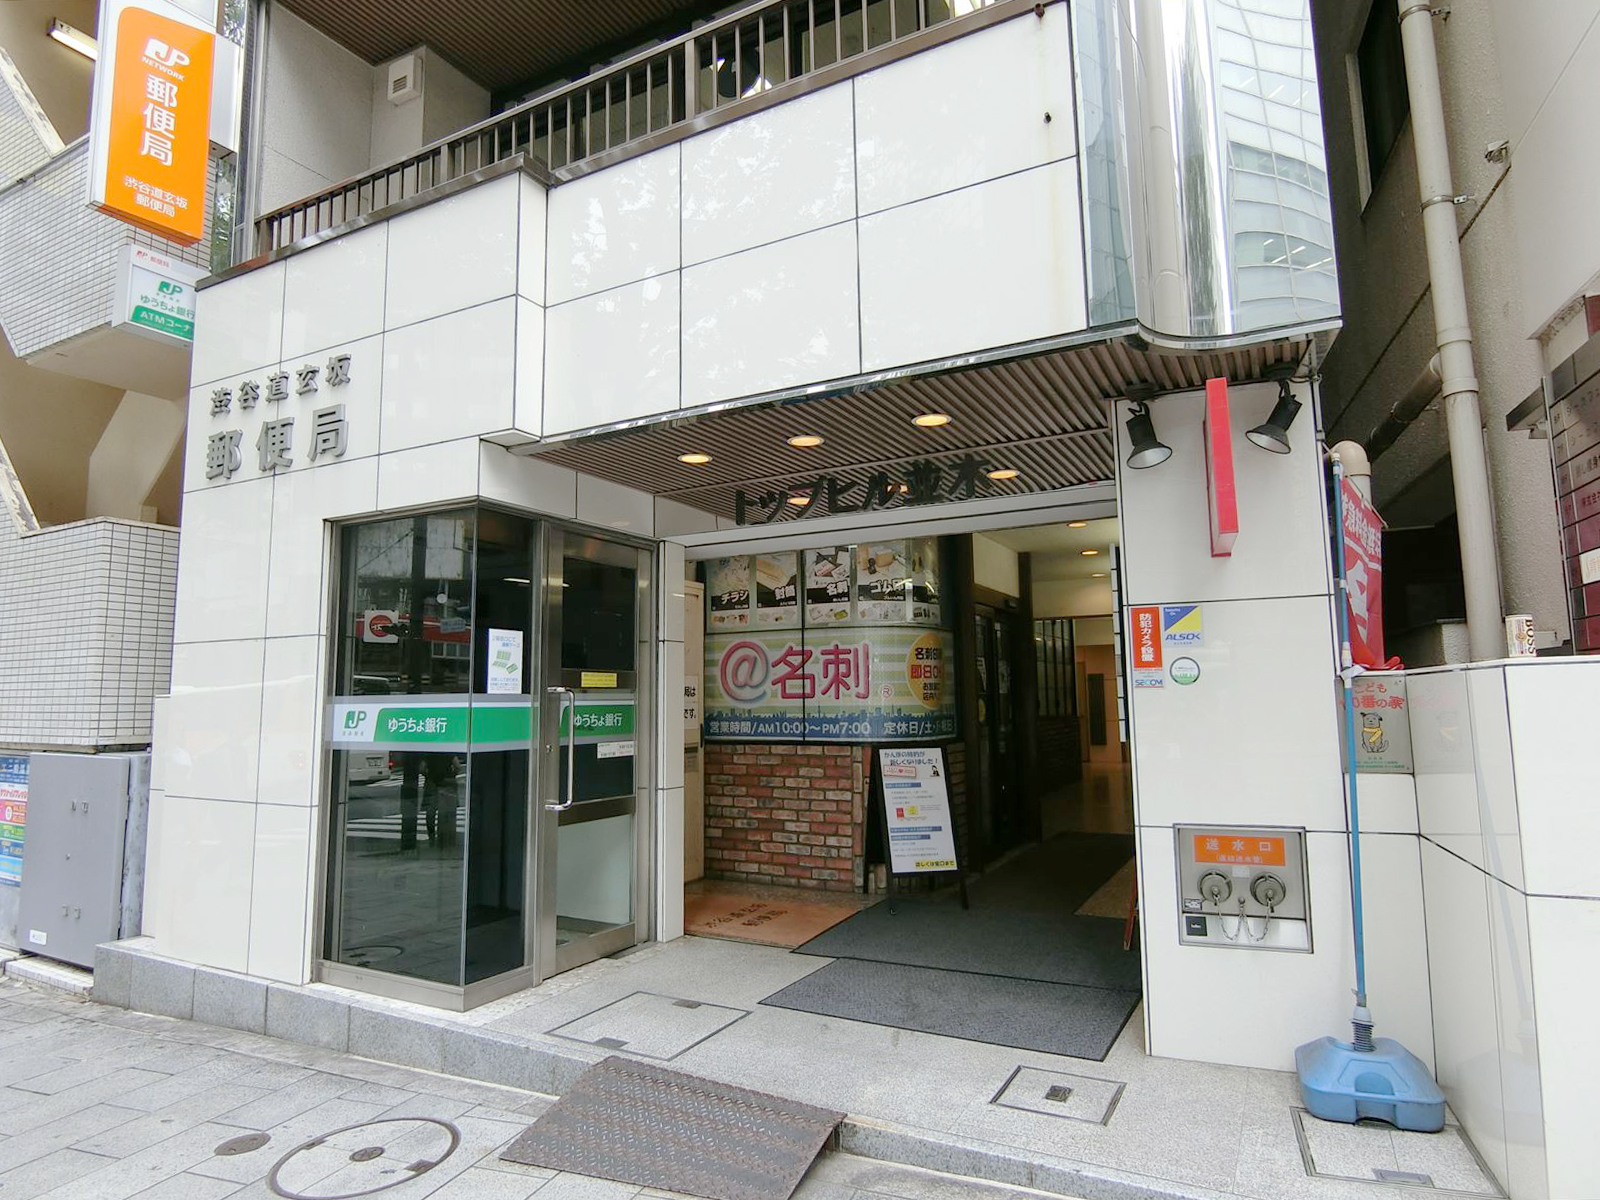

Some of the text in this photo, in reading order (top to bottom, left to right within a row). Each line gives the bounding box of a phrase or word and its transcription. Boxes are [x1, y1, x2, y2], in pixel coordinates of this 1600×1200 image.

[142, 56, 185, 81] NETWORK
[140, 74, 178, 166] 郵便局
[124, 175, 188, 210] 渋谷道玄坂
[134, 193, 176, 218] 郵便局
[210, 353, 352, 417] 渋谷道玄坂
[206, 403, 349, 480] 郵便局
[721, 589, 749, 604] チラシ
[774, 584, 796, 600] 封筒
[826, 580, 848, 596] 名刺
[1165, 633, 1201, 641] ALSOK
[1525, 619, 1536, 654] BOSS
[719, 640, 870, 702] @名刺
[388, 717, 447, 733] ゆうちょ銀行
[574, 713, 623, 727] ゆうちょ銀行
[1206, 838, 1271, 851] 送水口
